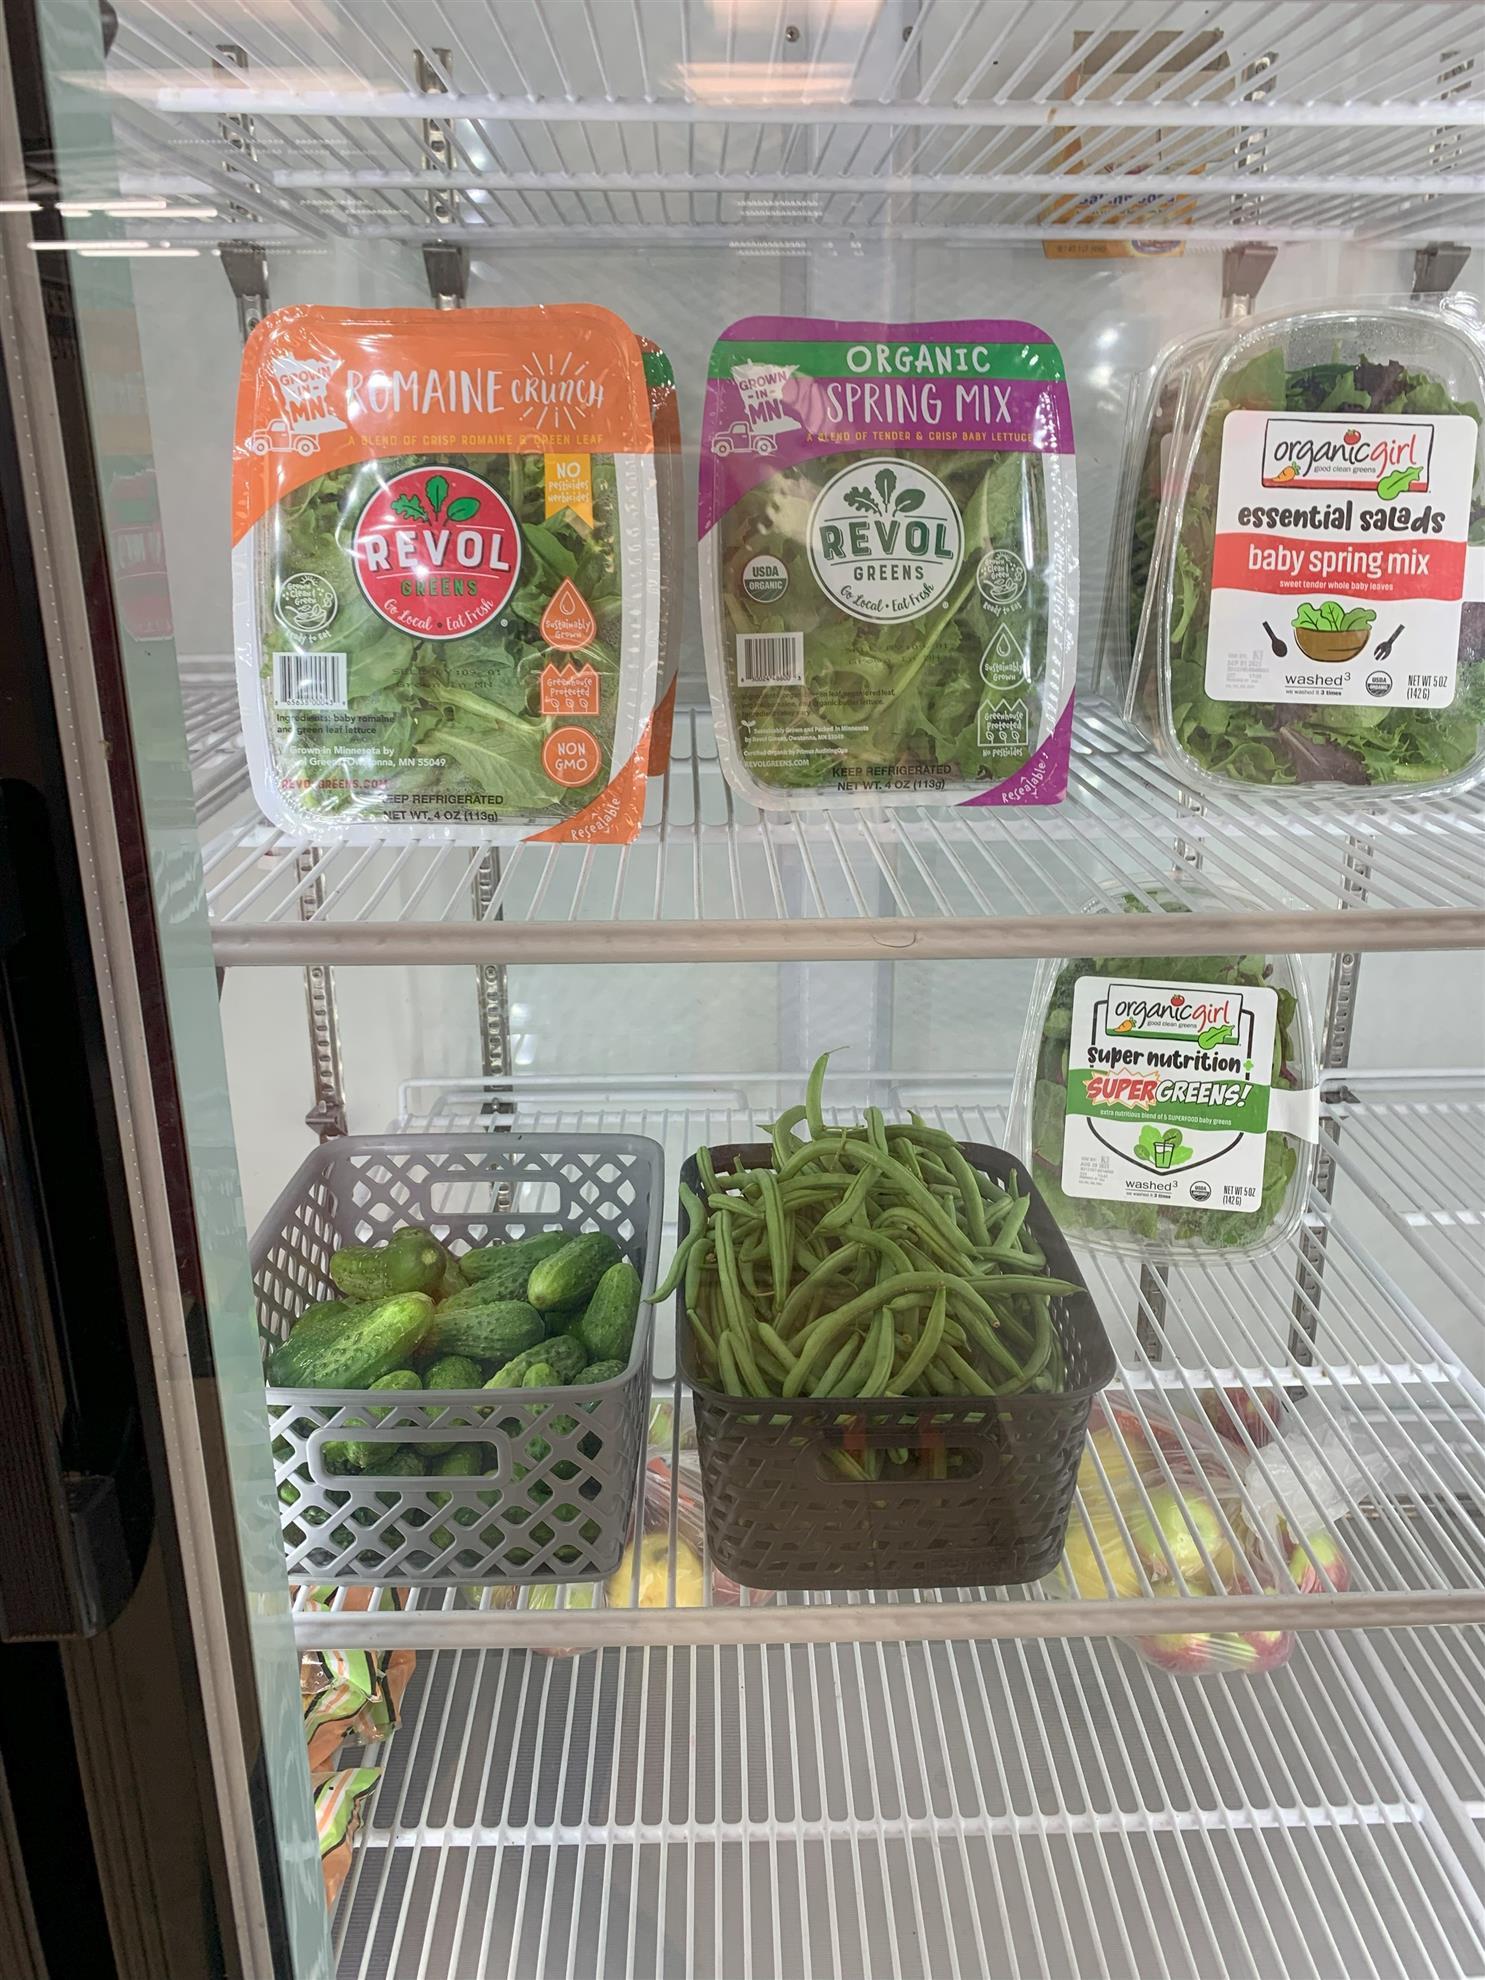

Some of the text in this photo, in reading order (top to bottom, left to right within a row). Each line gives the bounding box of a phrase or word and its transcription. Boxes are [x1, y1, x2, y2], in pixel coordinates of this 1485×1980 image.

[846, 343, 990, 375] ORGANIC
[279, 366, 331, 387] GROWN
[739, 370, 788, 392] GROWN
[346, 368, 504, 414] ROMAINE
[289, 395, 327, 424] MN
[826, 382, 1011, 424] SPRING MIX
[748, 399, 783, 425] MN
[348, 434, 604, 446] A BLEND OF CRISP ROMAINE & GREEN LEAF
[806, 431, 1032, 442] A BLEND OF TENDER & CRISP BABY LETTUCE
[1273, 433, 1417, 478] organicgirl
[556, 462, 581, 479] NO
[1313, 465, 1376, 475] good clean greens
[1238, 500, 1445, 534] essential salads
[819, 520, 954, 560] REVOL
[363, 529, 511, 572] REVOL
[1248, 543, 1431, 579] baby spring mix
[752, 566, 779, 578] USDA
[853, 564, 925, 581] GREENS
[401, 578, 478, 596] GREENS
[749, 580, 783, 590] ORGANIC
[1279, 580, 1394, 592] sweet tender whole baby leaves
[840, 582, 935, 613] Go Local Eat Fresh
[384, 598, 494, 631] Go Local Eat Fresh
[554, 631, 582, 639] Grown
[546, 677, 593, 687] Greenhouse
[993, 673, 1016, 681] Grown
[1407, 674, 1448, 688] NET WT 5 OZ
[549, 687, 590, 697] Protected
[333, 714, 395, 725] baby romaine
[984, 710, 1024, 721] Greenhouse
[297, 728, 323, 738] green
[325, 726, 342, 736] leaf
[345, 726, 377, 736] lettuce
[987, 720, 1022, 731] Protected
[290, 746, 395, 757] Grown in Minnesota by
[557, 742, 586, 757] NON
[992, 747, 1023, 758] Pesticides
[399, 759, 447, 768] MN 55049
[555, 758, 588, 771] GMO
[832, 764, 951, 778] KEEP REFRIGERATED
[837, 778, 945, 791] NET WT. 4 OZ (113g)
[1001, 759, 1046, 803] Resealable
[412, 794, 504, 805] REFRIGERATED
[410, 811, 431, 821] WT.
[433, 811, 440, 820] 4
[443, 811, 461, 820] OZ
[464, 811, 498, 823] (113g)
[571, 797, 621, 841] Resealable
[1114, 1000, 1230, 1032] organicgirl
[1146, 1020, 1161, 1028] good
[1178, 1022, 1198, 1030] greens
[1087, 1046, 1241, 1073] super nutrition
[1114, 1110, 1141, 1118] nutritious
[1141, 1112, 1157, 1120] blend
[1168, 1114, 1199, 1123] SUPERFOOD
[1199, 1117, 1213, 1126] baby
[1212, 1118, 1232, 1127] greens
[1223, 1185, 1256, 1197] NET WT 5 OZ
